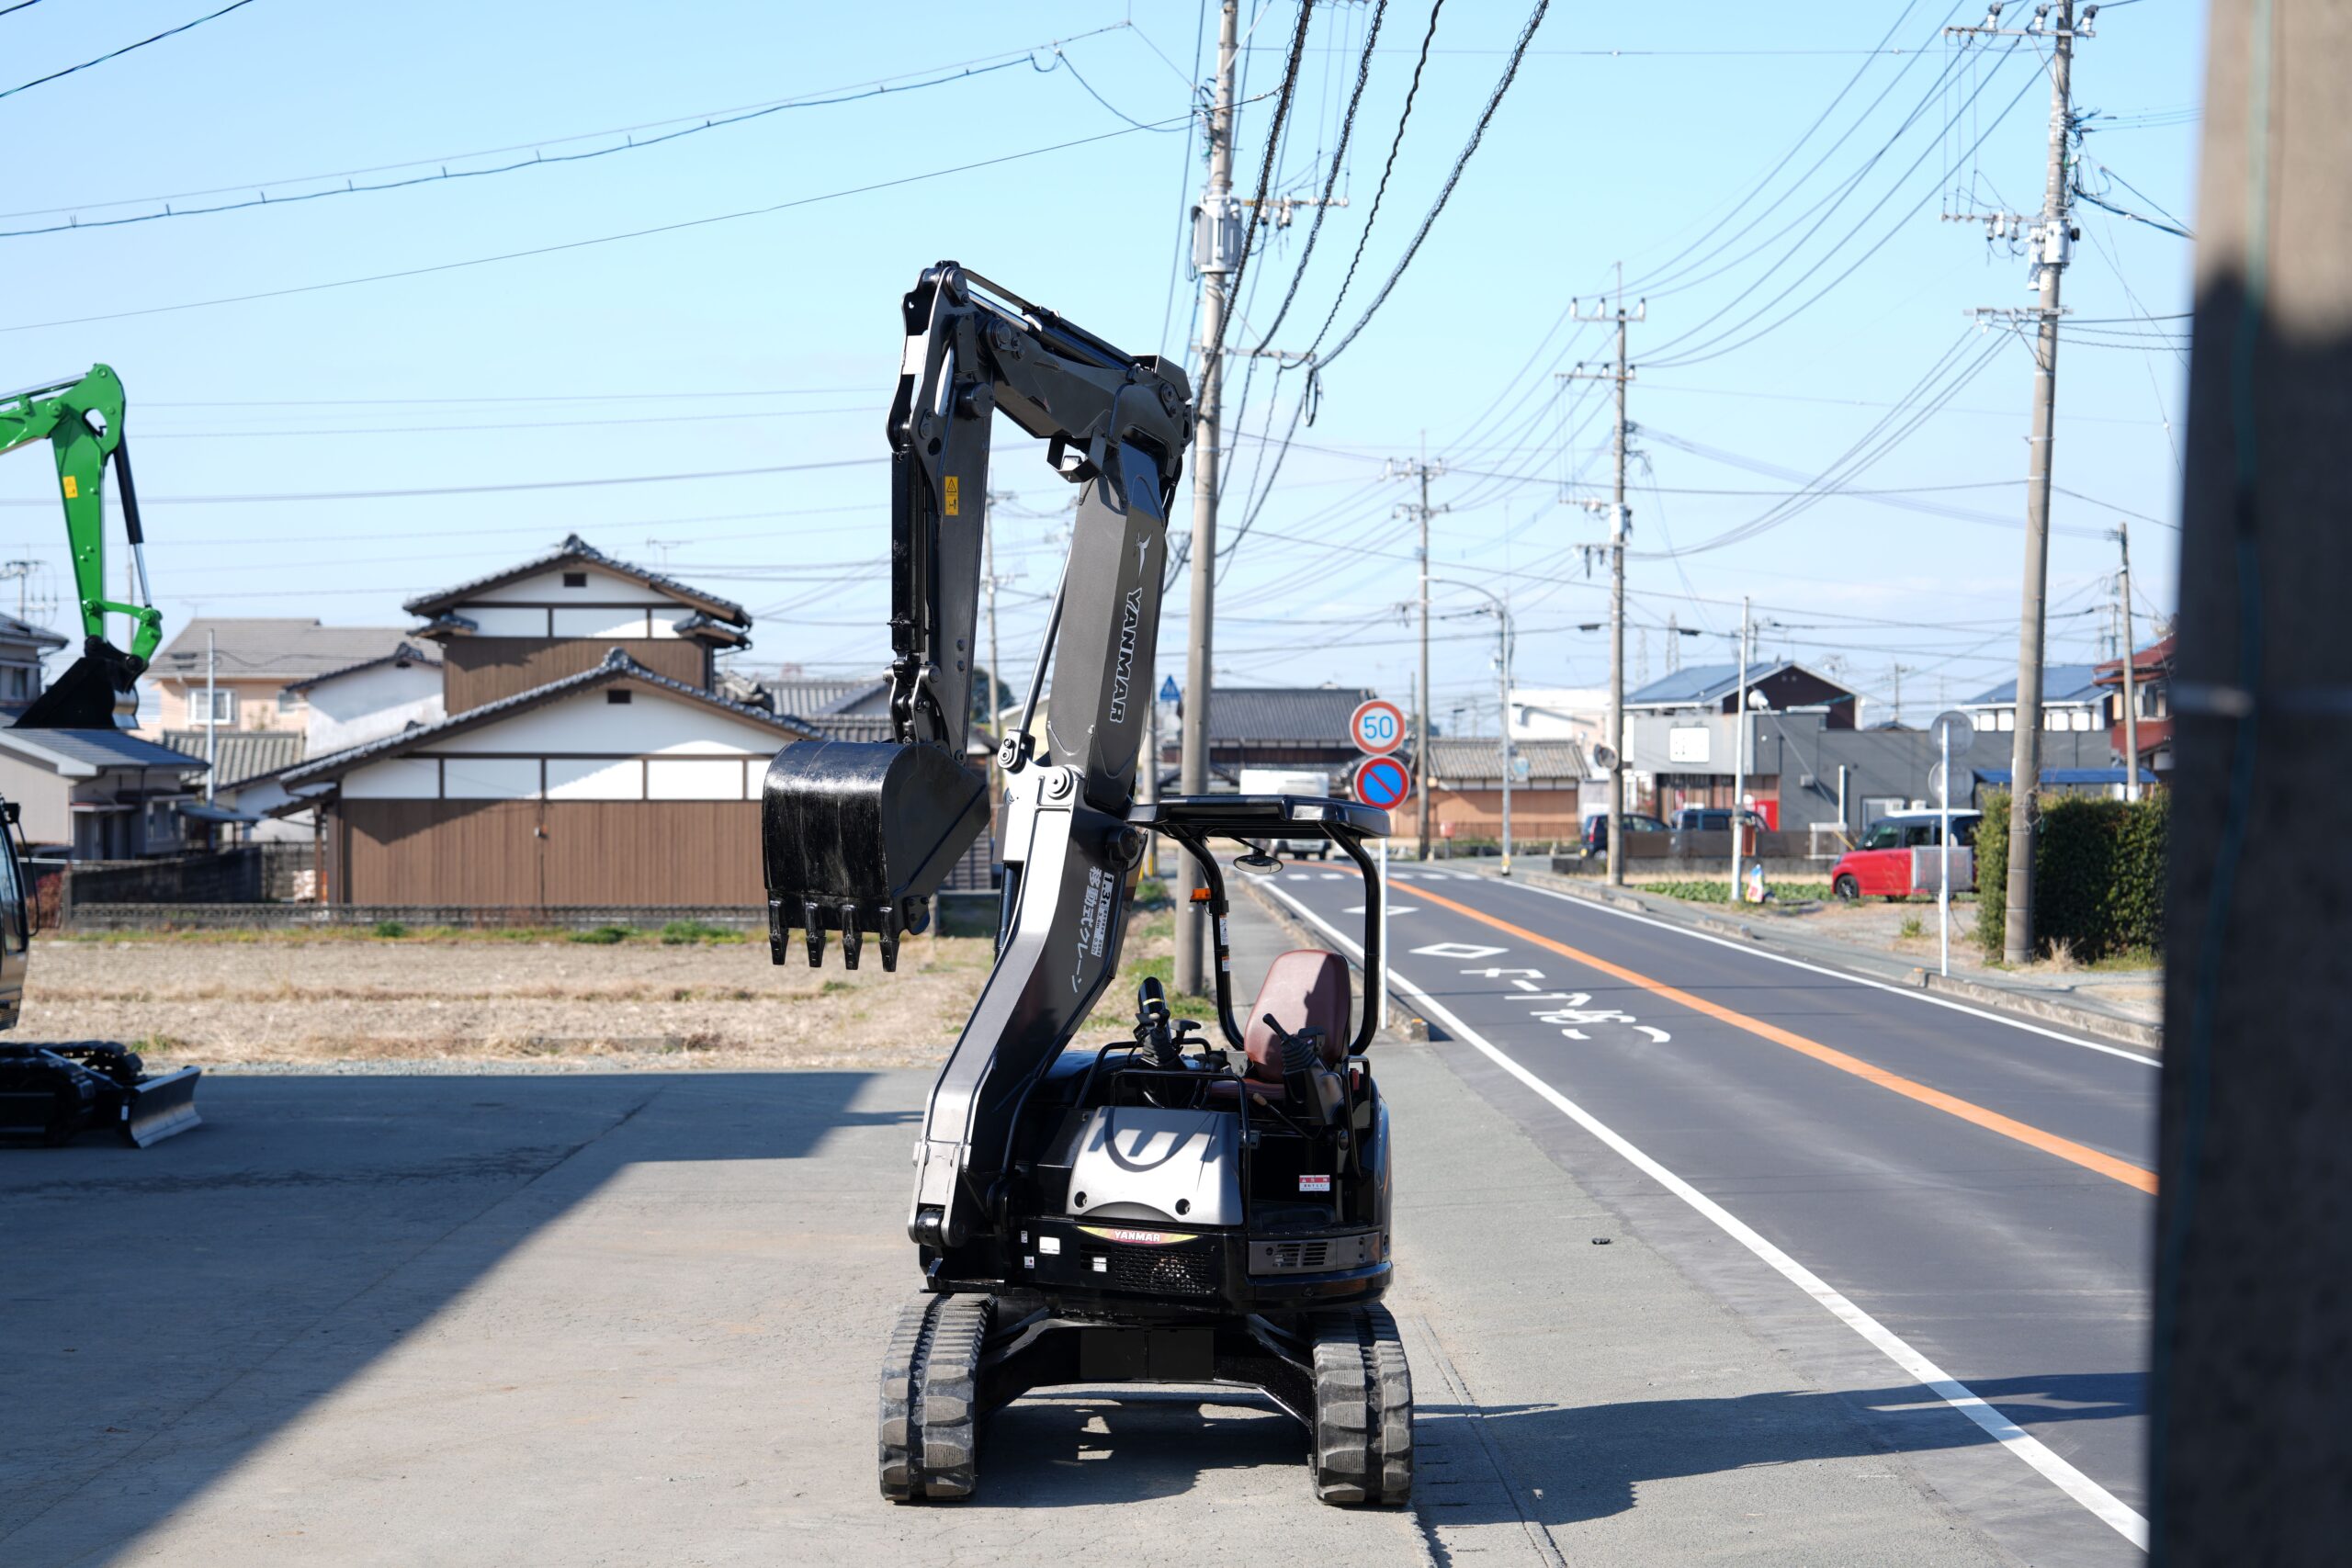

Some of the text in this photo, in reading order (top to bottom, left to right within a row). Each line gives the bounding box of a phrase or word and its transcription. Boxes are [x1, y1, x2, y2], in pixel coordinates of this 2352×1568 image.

[1110, 587, 1142, 724] YANMAR
[1364, 716, 1393, 739] 50
[1102, 875, 1114, 906] 1.3t
[1071, 865, 1102, 993] 移動式クレーン
[1114, 1230, 1160, 1242] YANMAR
